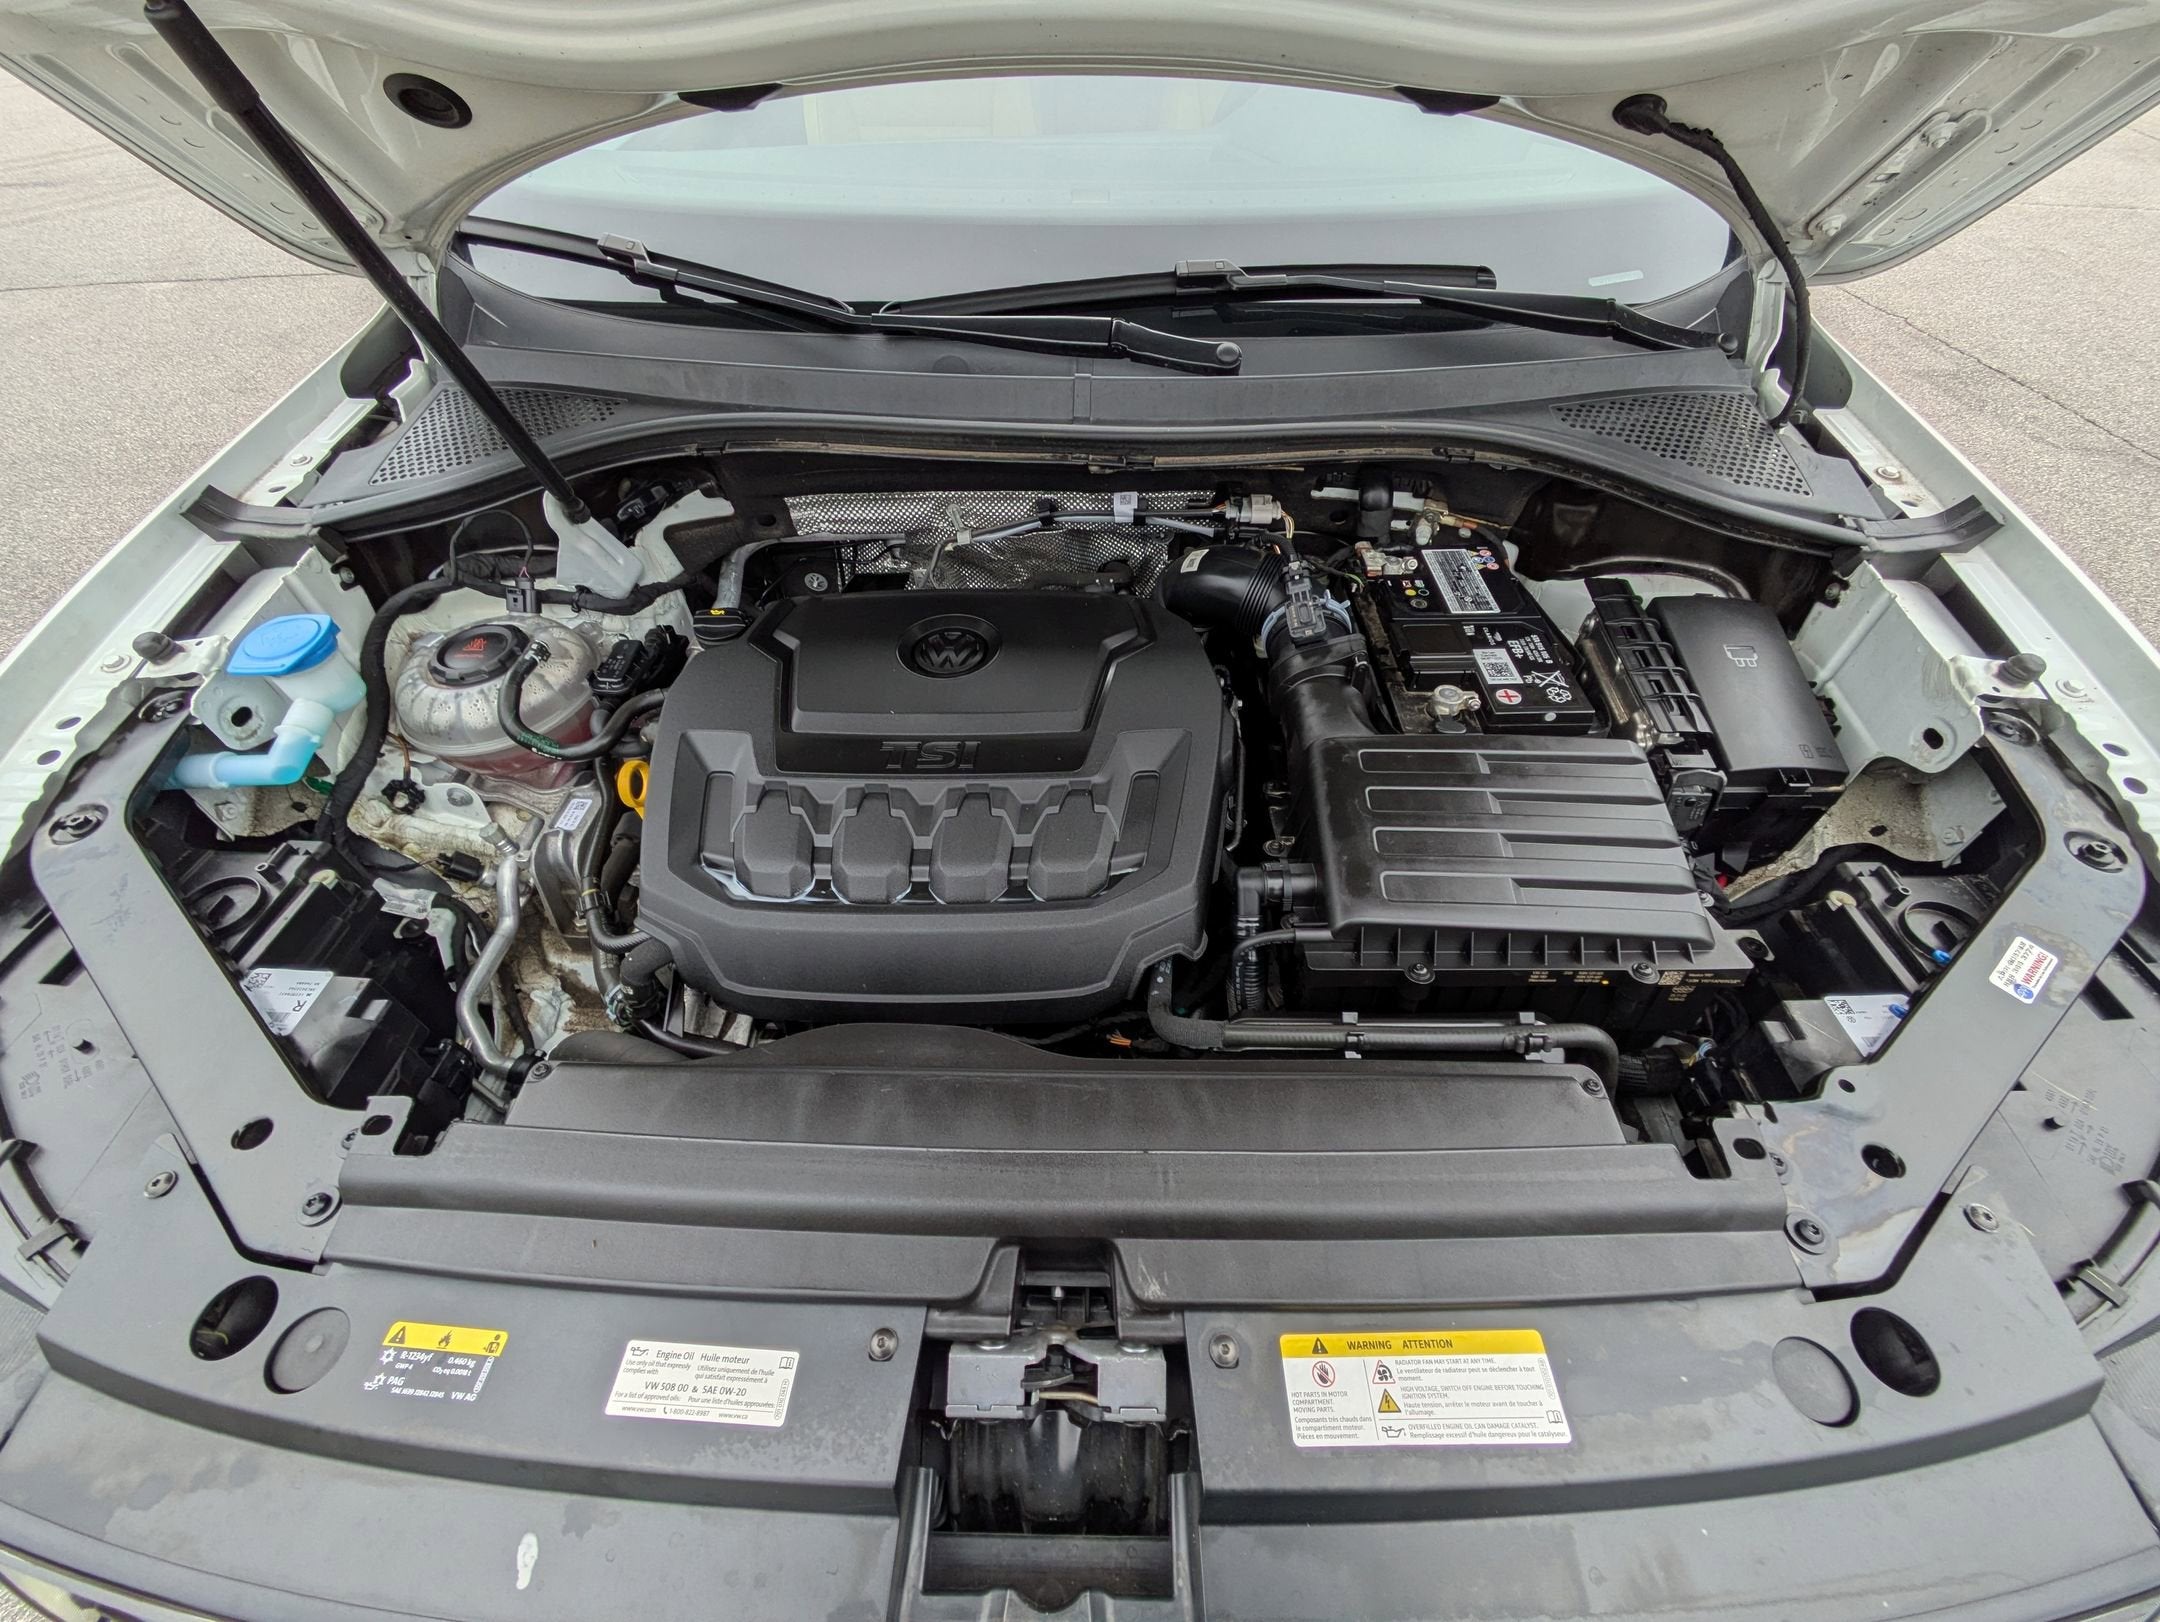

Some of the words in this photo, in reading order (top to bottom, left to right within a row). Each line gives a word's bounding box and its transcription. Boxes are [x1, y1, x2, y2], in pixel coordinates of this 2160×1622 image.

[1507, 640, 1524, 658] EFB+
[880, 741, 981, 768] TSI
[2021, 952, 2048, 985] WARNING!
[1347, 1340, 1392, 1350] WARNING
[1402, 1339, 1453, 1349] ATTENTION
[400, 1351, 433, 1362] R-1234yf
[656, 1350, 682, 1361] Engine
[683, 1352, 695, 1360] Oil
[700, 1353, 720, 1361] Huile
[722, 1355, 750, 1364] moteur
[468, 1358, 476, 1368] kg
[667, 1363, 691, 1371] expressly
[717, 1367, 750, 1375] uniquement
[387, 1376, 405, 1386] PAG
[645, 1381, 660, 1390] VW
[660, 1383, 676, 1391] 508
[677, 1384, 689, 1392] 00
[692, 1385, 698, 1393] &
[702, 1386, 718, 1395] SAE
[720, 1387, 747, 1397] 0W-20
[451, 1392, 464, 1400] VW
[465, 1393, 477, 1401] AG
[645, 1394, 669, 1402] approved
